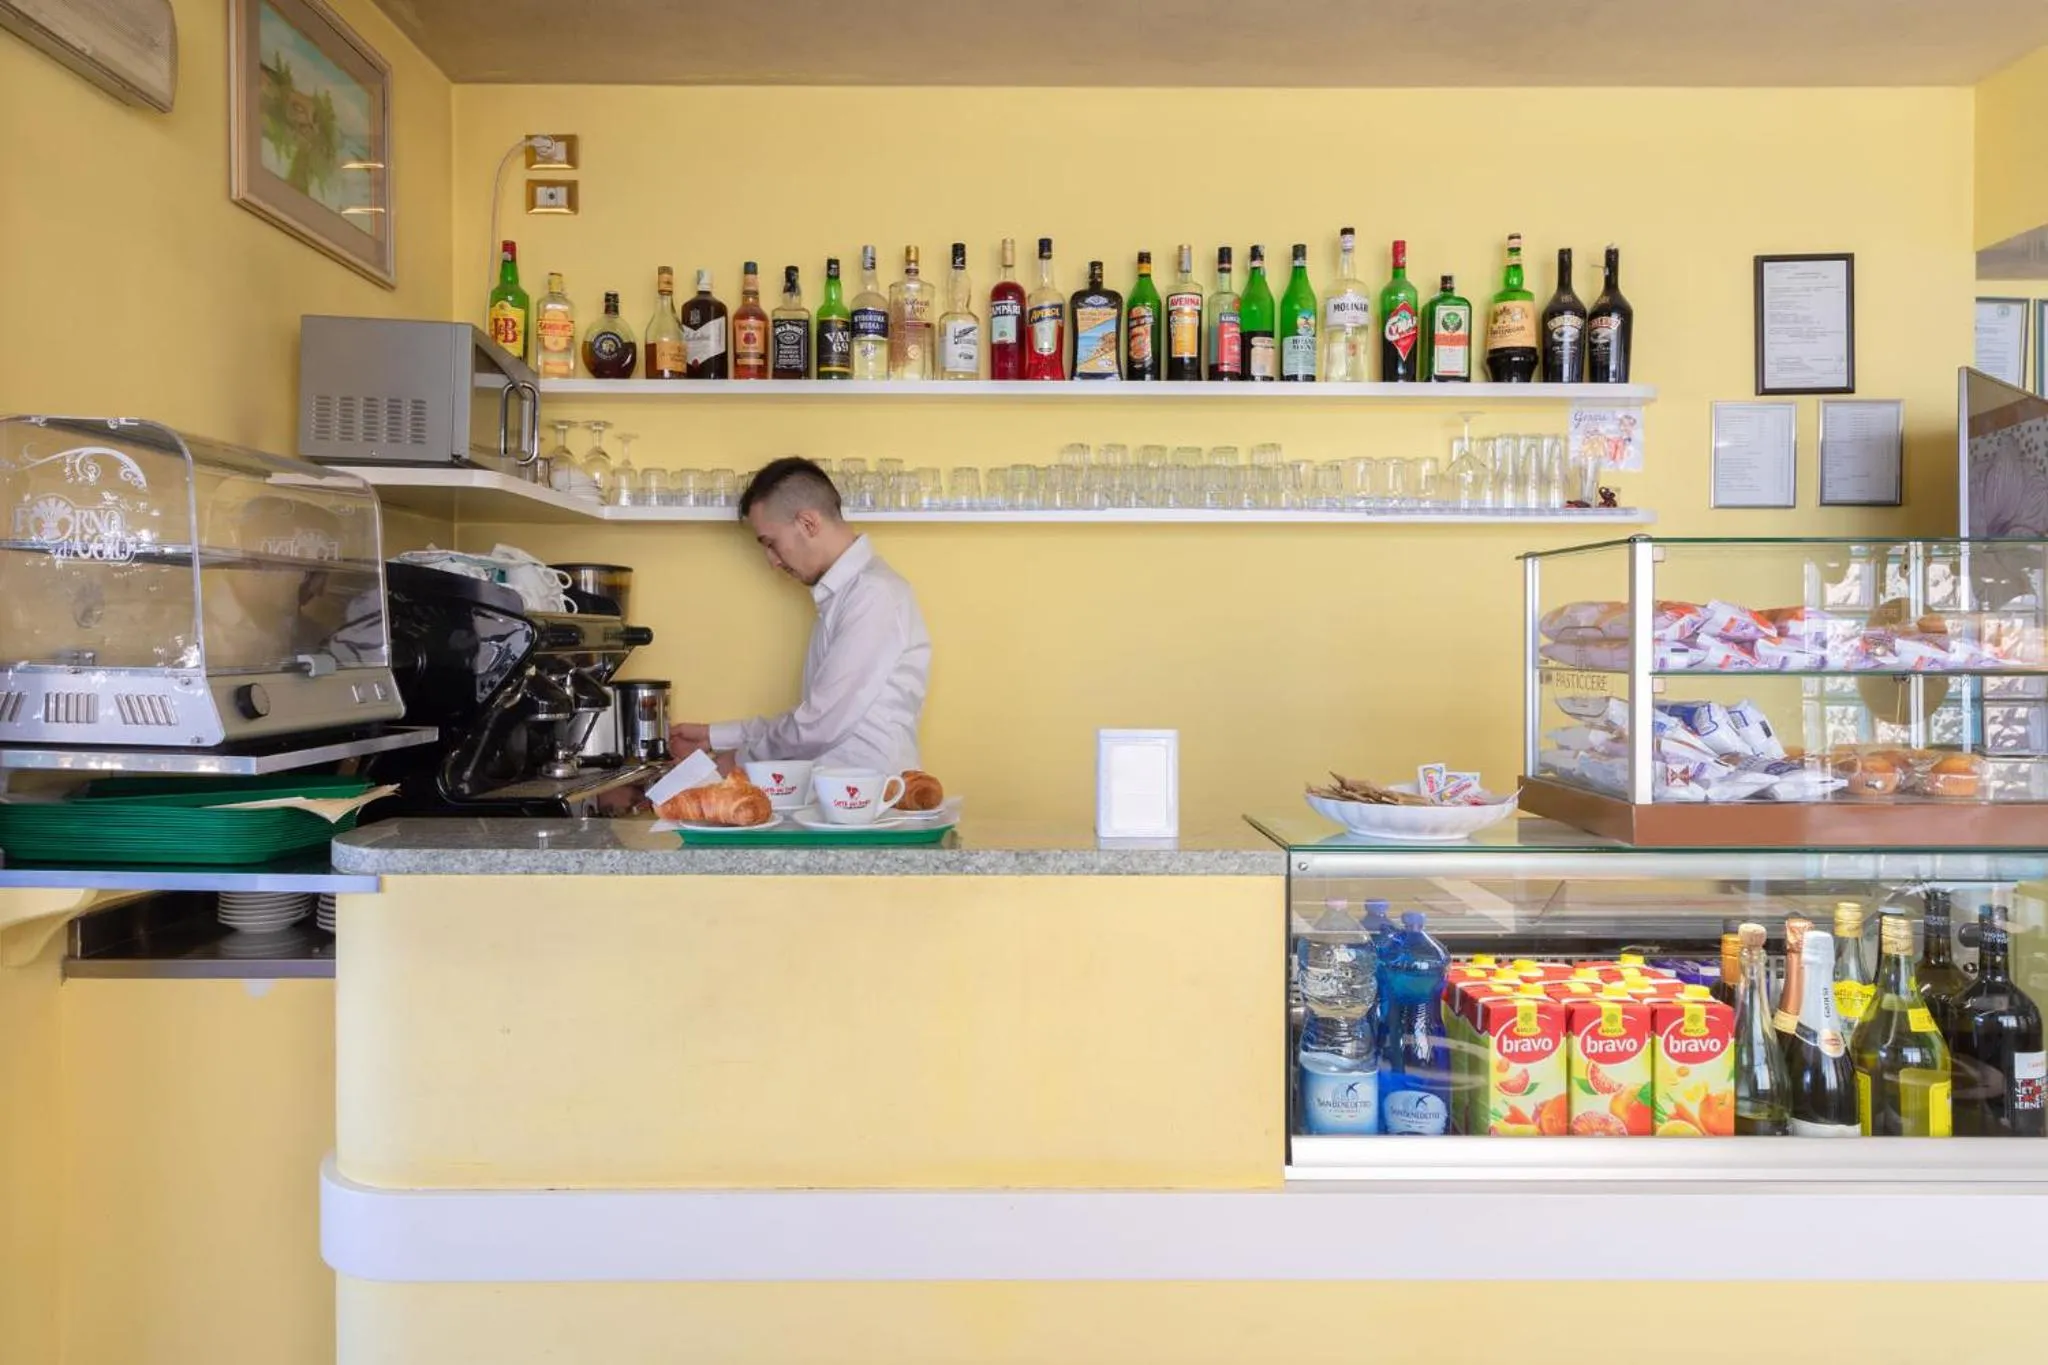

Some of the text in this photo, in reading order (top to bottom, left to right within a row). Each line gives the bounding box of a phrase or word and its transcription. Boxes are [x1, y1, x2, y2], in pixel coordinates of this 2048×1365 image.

[832, 343, 849, 353] 69
[1502, 1034, 1553, 1053] bravo
[1586, 1034, 1637, 1053] bravo
[1669, 1033, 1721, 1053] bravo
